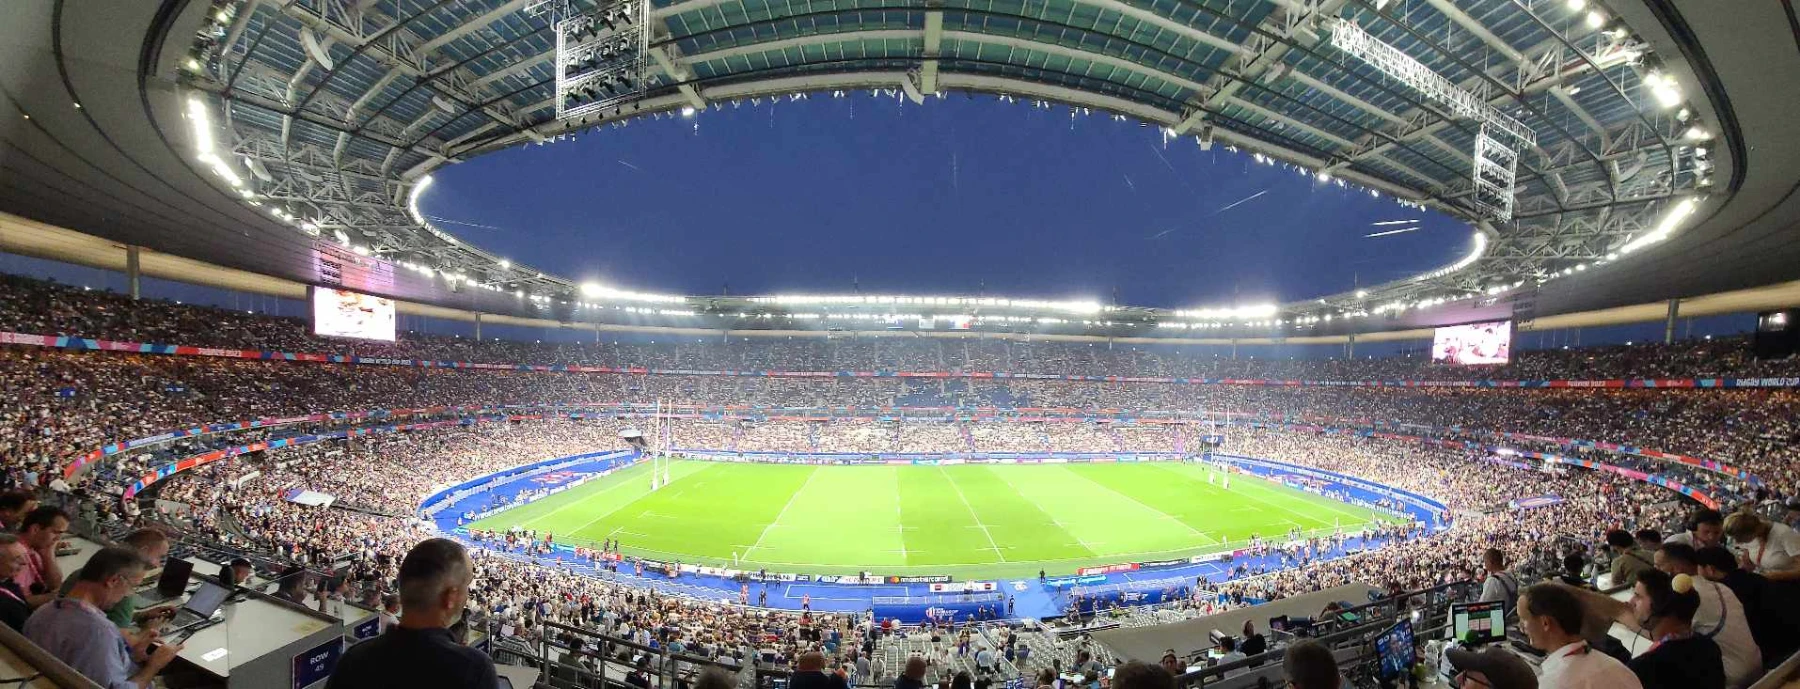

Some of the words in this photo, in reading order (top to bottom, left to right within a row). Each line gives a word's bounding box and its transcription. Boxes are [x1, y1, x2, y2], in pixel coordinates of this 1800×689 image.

[1736, 378, 1760, 387] RUGBY
[1760, 377, 1785, 387] WORLD
[1786, 377, 1800, 387] CUP
[310, 651, 329, 665] ROW
